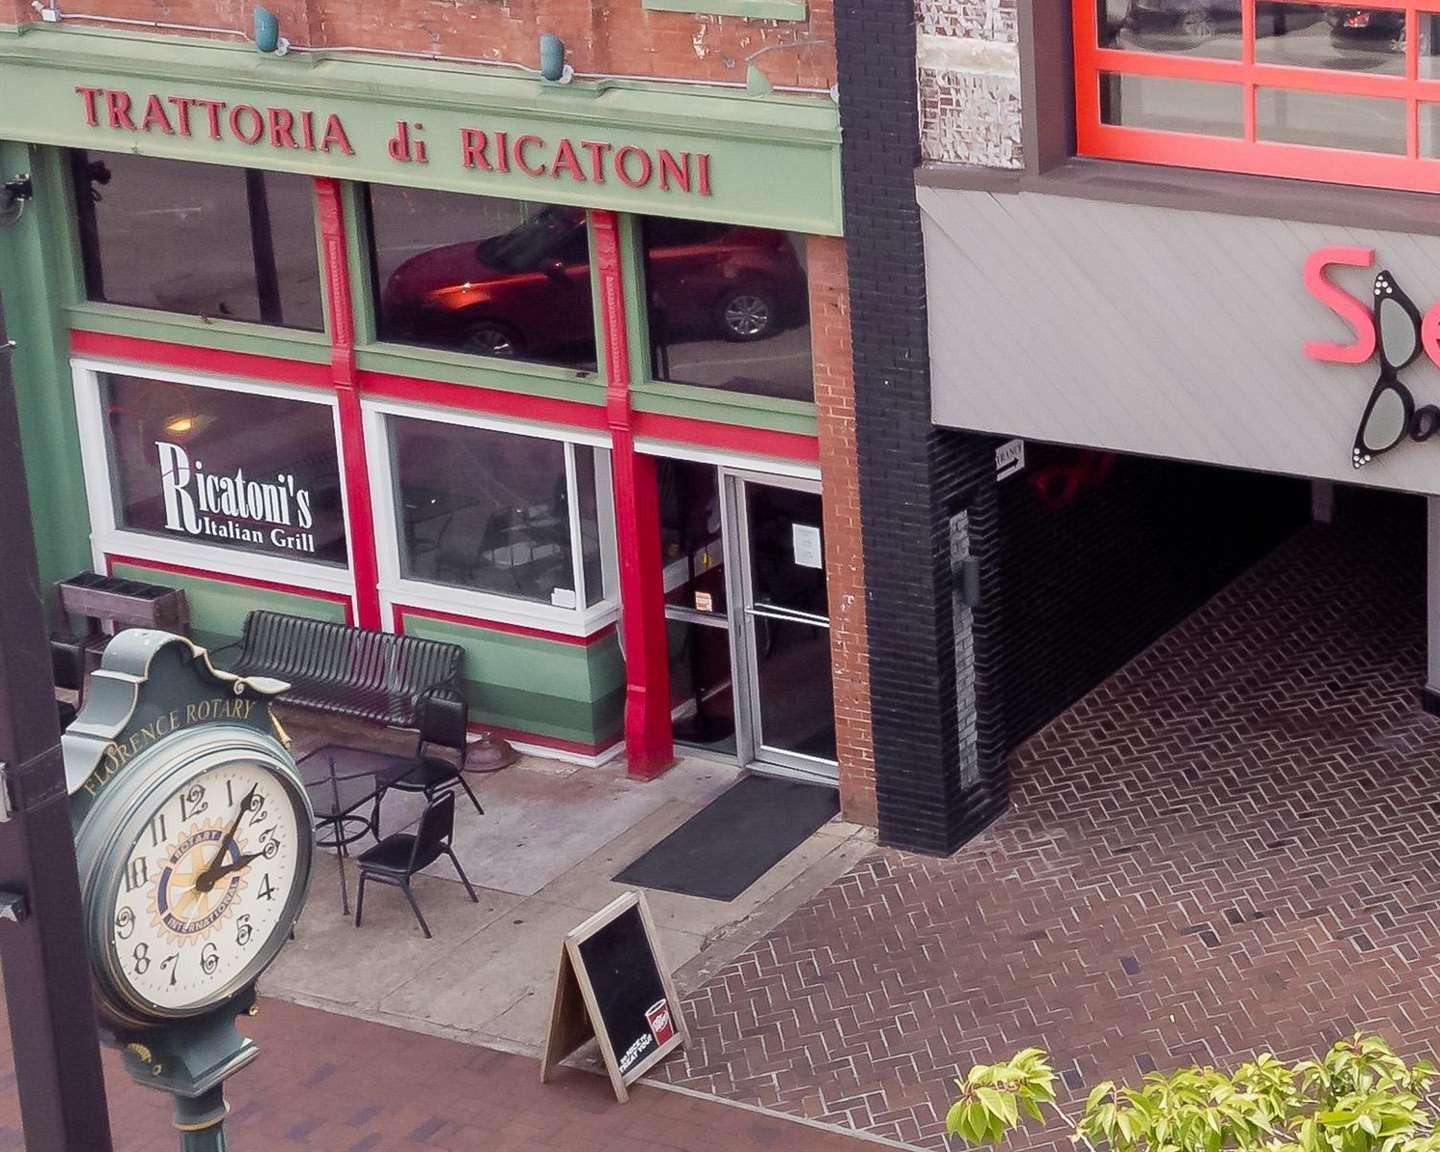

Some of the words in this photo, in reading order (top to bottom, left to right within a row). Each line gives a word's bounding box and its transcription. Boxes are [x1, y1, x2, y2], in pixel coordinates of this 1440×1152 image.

[73, 85, 356, 156] TRATTORIA
[387, 120, 429, 163] di
[458, 127, 711, 197] RICATONI
[155, 441, 313, 534] Ricatoni's
[204, 517, 264, 544] Italian
[270, 529, 315, 553] Grill
[84, 711, 180, 798] FLORENCE
[186, 698, 255, 725] ROTARY
[180, 784, 208, 822] 12
[226, 780, 233, 807] 1
[249, 794, 267, 825] 2
[151, 814, 167, 847] 11
[259, 825, 280, 859] 3
[125, 856, 148, 892] 10
[257, 873, 275, 901] 4
[116, 906, 135, 939] 9
[236, 914, 252, 946] 5
[134, 943, 150, 974] 8
[160, 953, 179, 985] 7
[201, 943, 219, 975] 6
